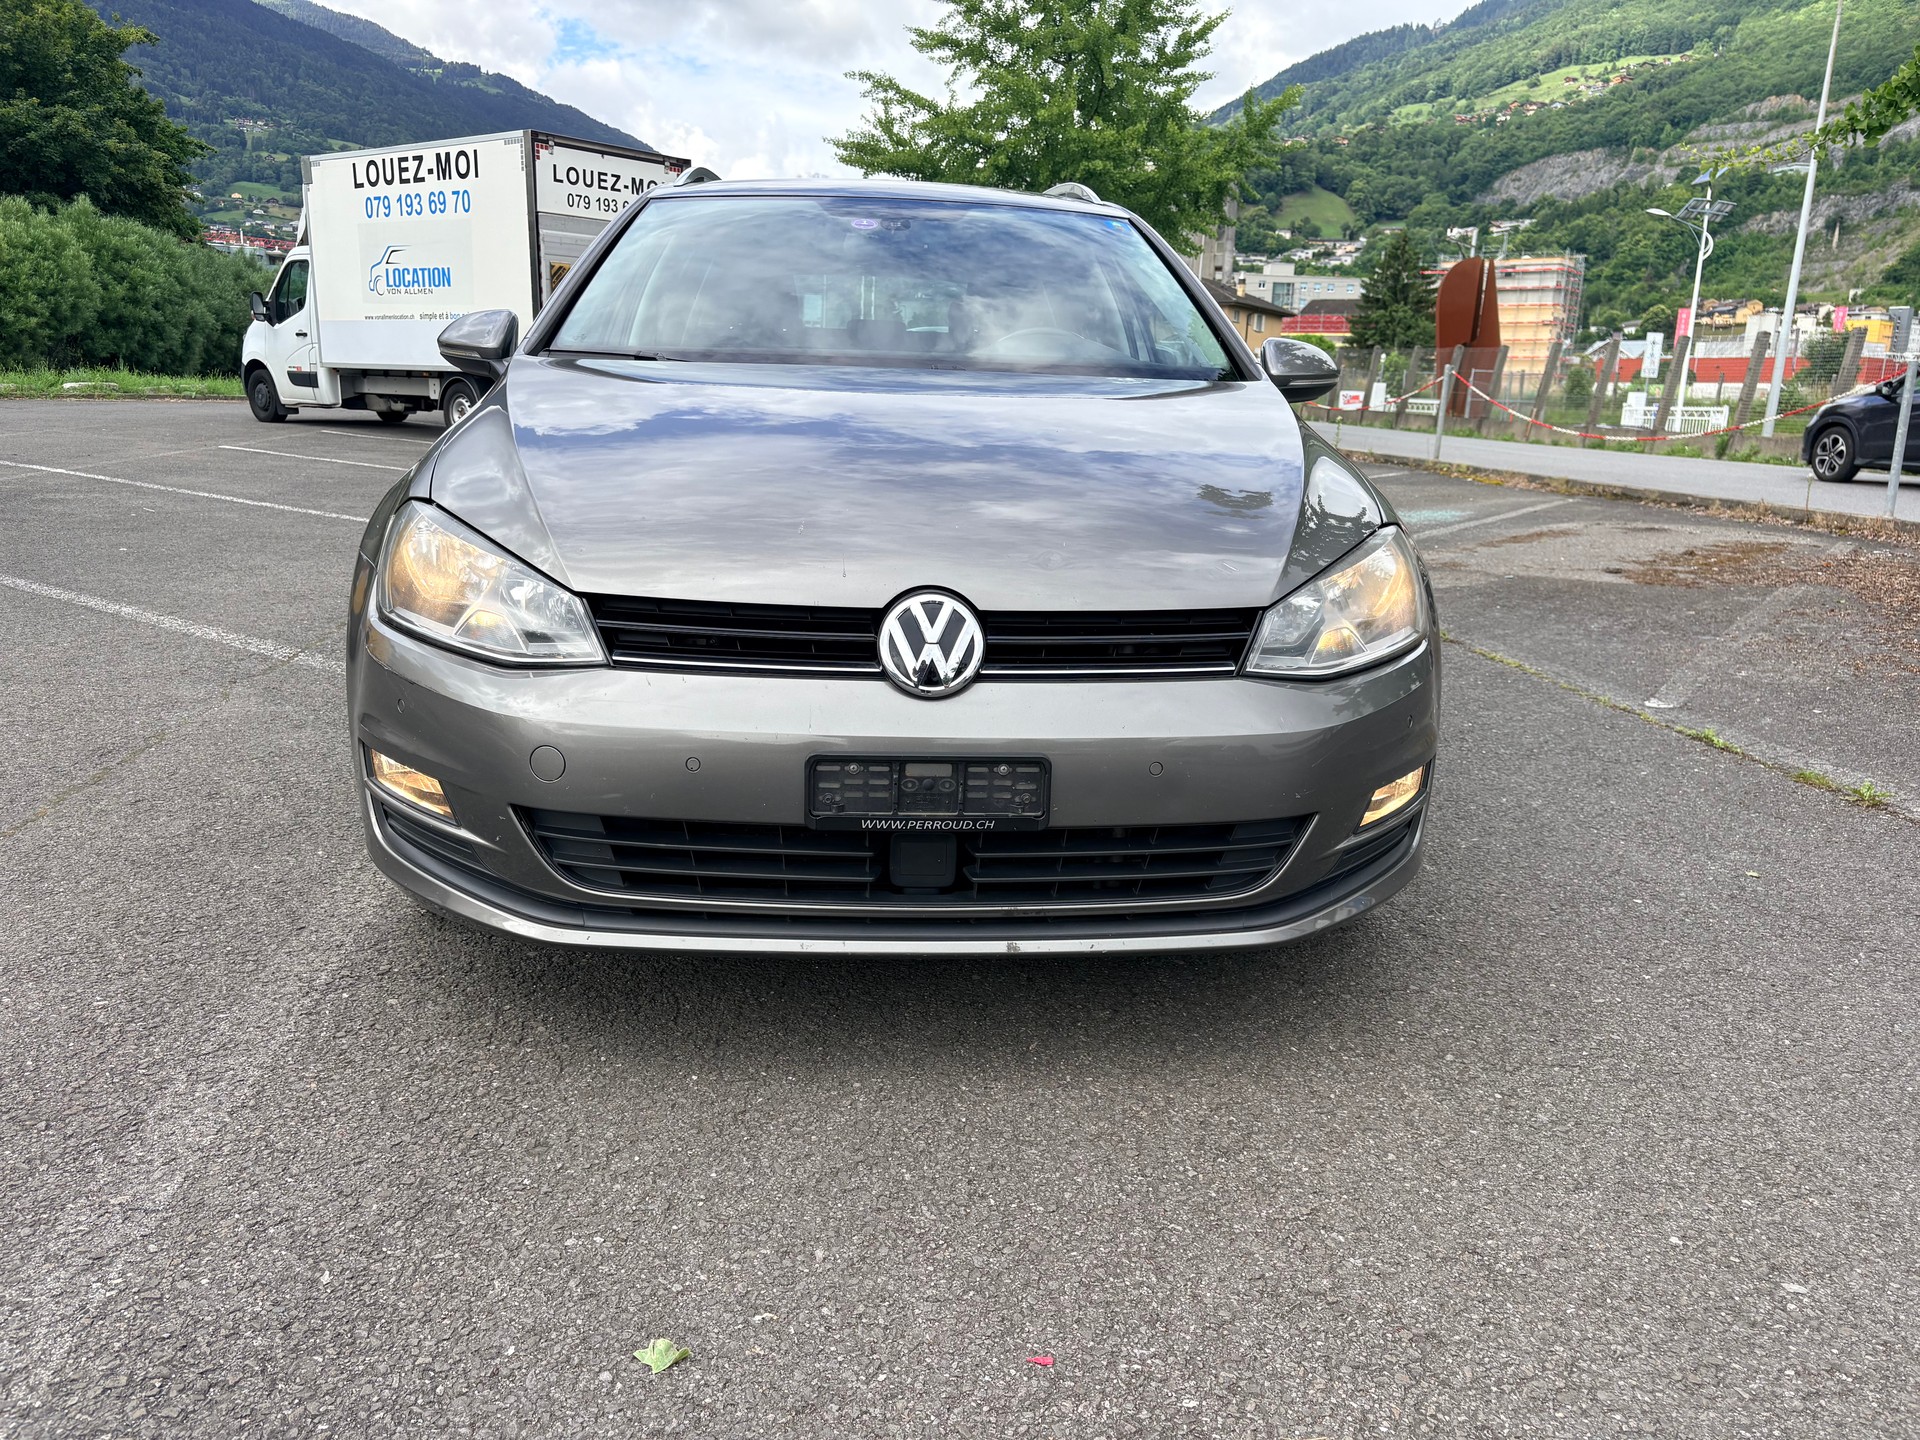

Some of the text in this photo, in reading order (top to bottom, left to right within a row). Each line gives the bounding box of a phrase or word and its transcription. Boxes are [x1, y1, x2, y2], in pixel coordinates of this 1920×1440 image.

[352, 149, 479, 189] LOUEZ-MOI
[553, 163, 664, 196] LOUEZ-M
[365, 189, 471, 219] 079 193 69 70
[567, 193, 591, 210] 079
[595, 197, 619, 213] 193
[385, 267, 452, 288] LOCATION
[419, 311, 437, 321] simple
[439, 311, 445, 320] et
[449, 311, 461, 320] bon
[861, 819, 996, 830] WWW.PERROUD.CH
